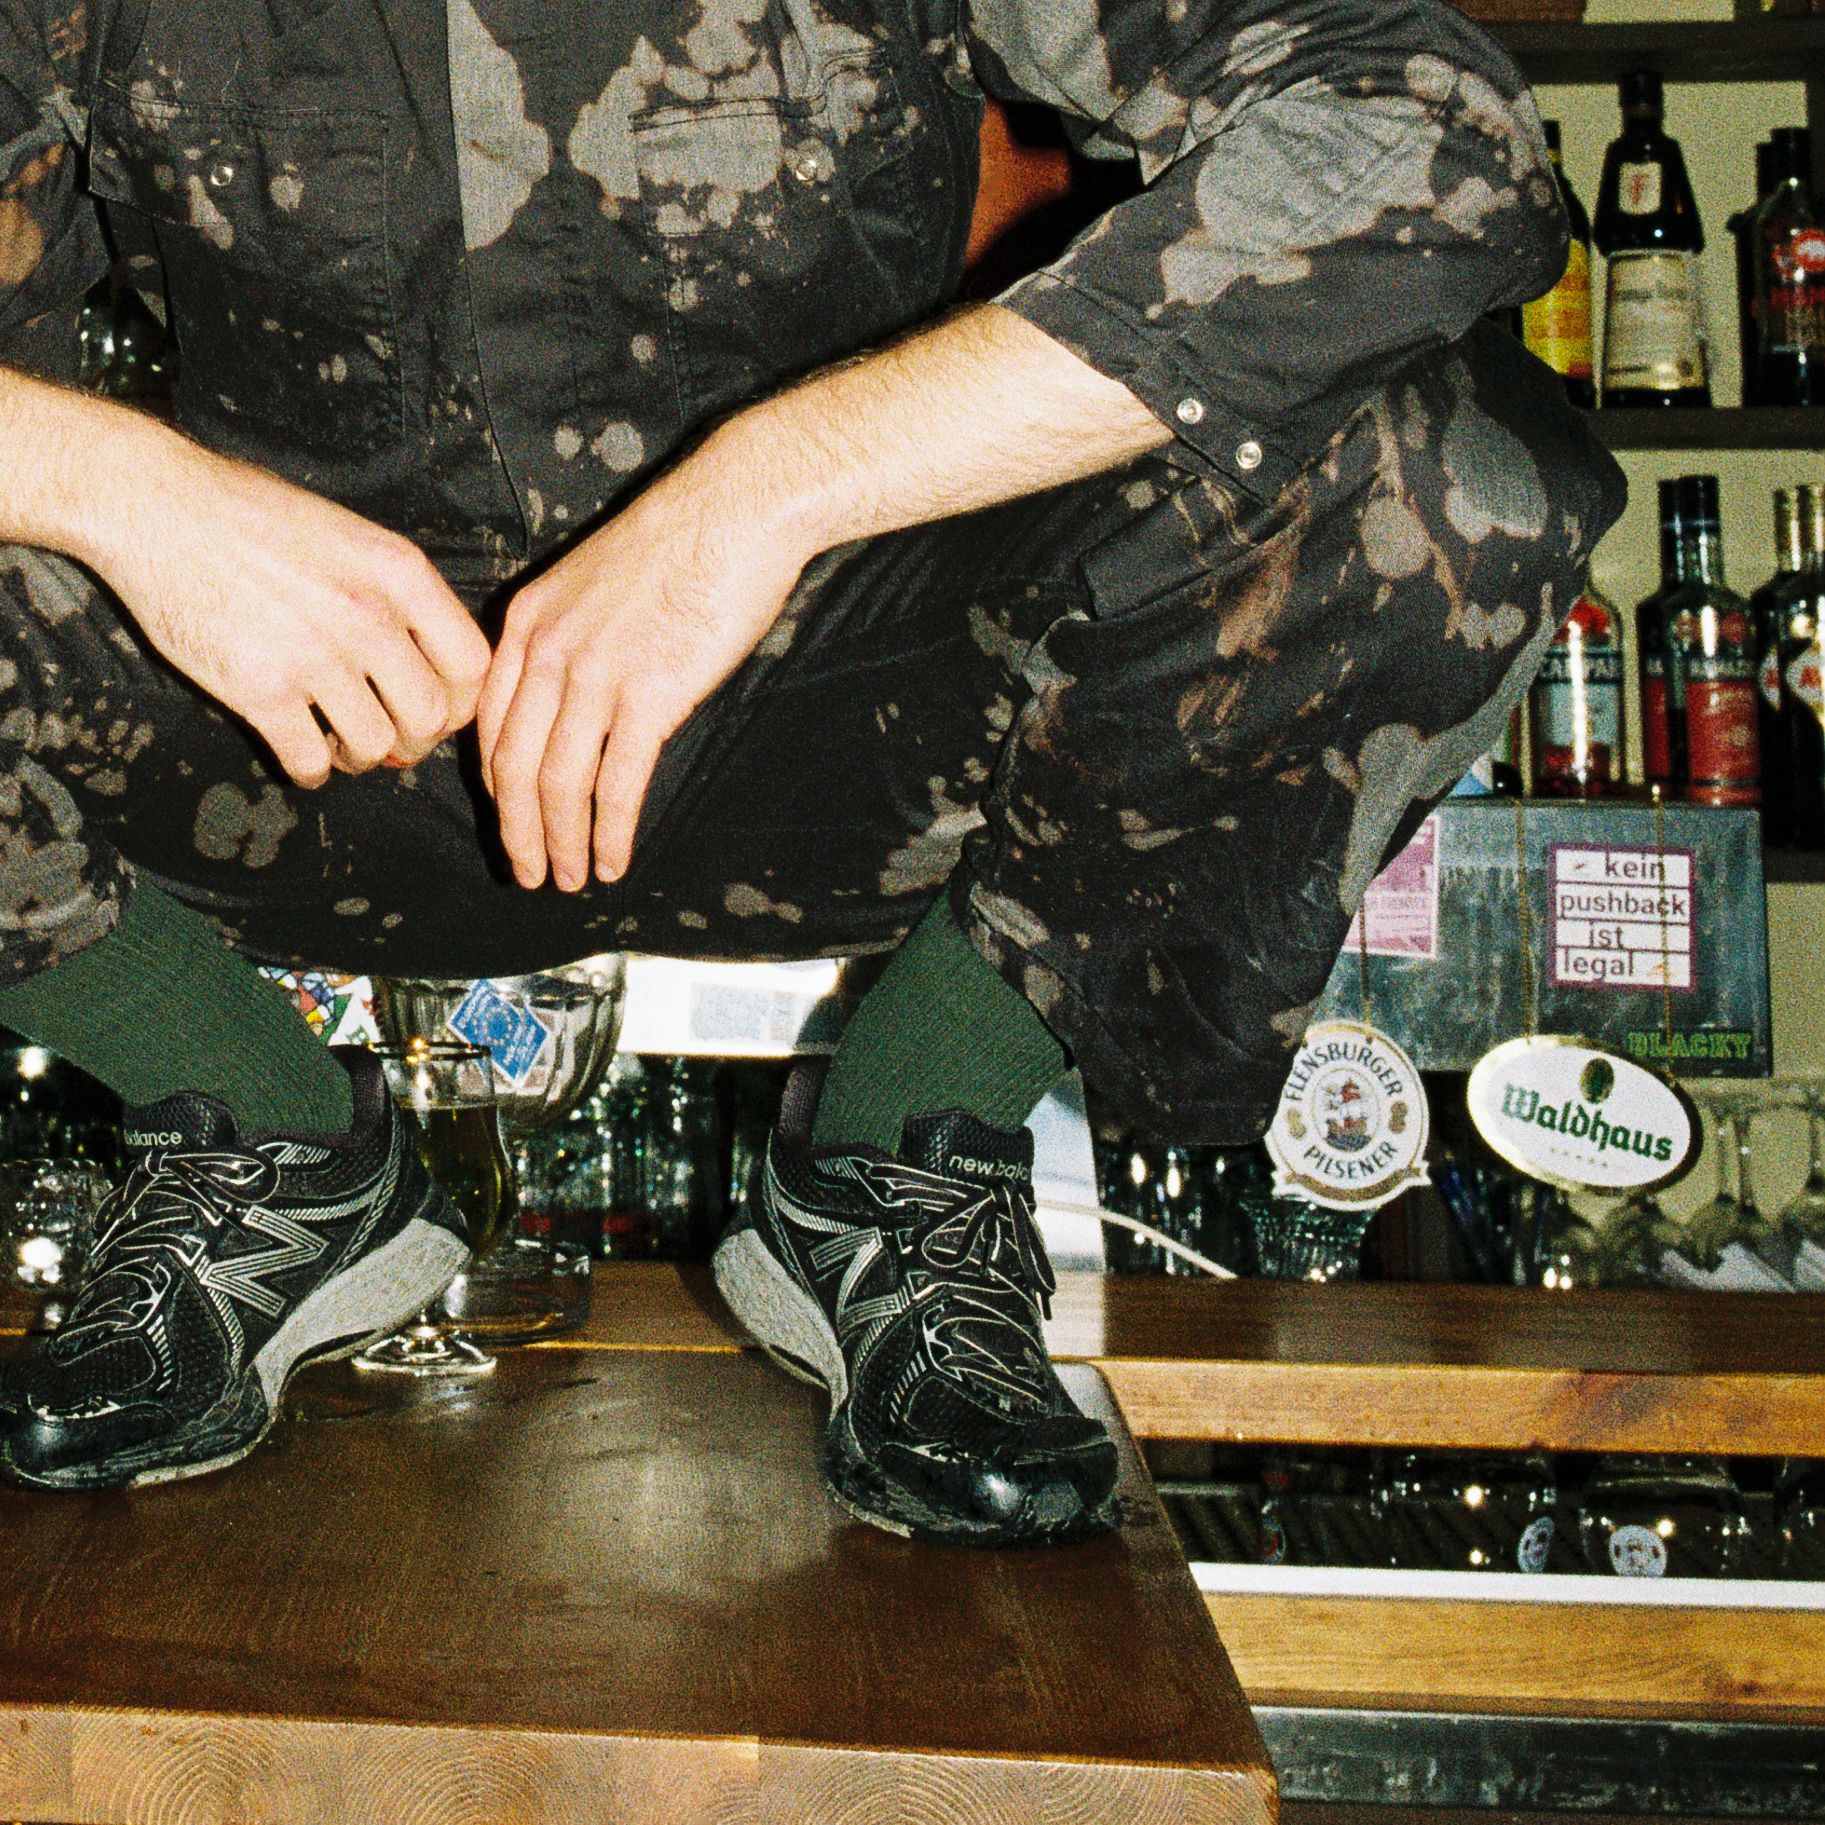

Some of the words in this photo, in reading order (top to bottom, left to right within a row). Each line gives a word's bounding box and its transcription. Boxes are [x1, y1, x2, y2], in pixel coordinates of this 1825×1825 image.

[1605, 846, 1665, 881] kein
[1560, 890, 1685, 919] pushback
[1588, 920, 1624, 950] ist
[1564, 946, 1634, 982] legal
[1628, 1031, 1752, 1059] BLACKY
[1285, 1042, 1403, 1102] FLENSBURGER
[1501, 1082, 1674, 1162] Waldhaus
[948, 1154, 994, 1176] new
[1303, 1140, 1399, 1179] PILSENER
